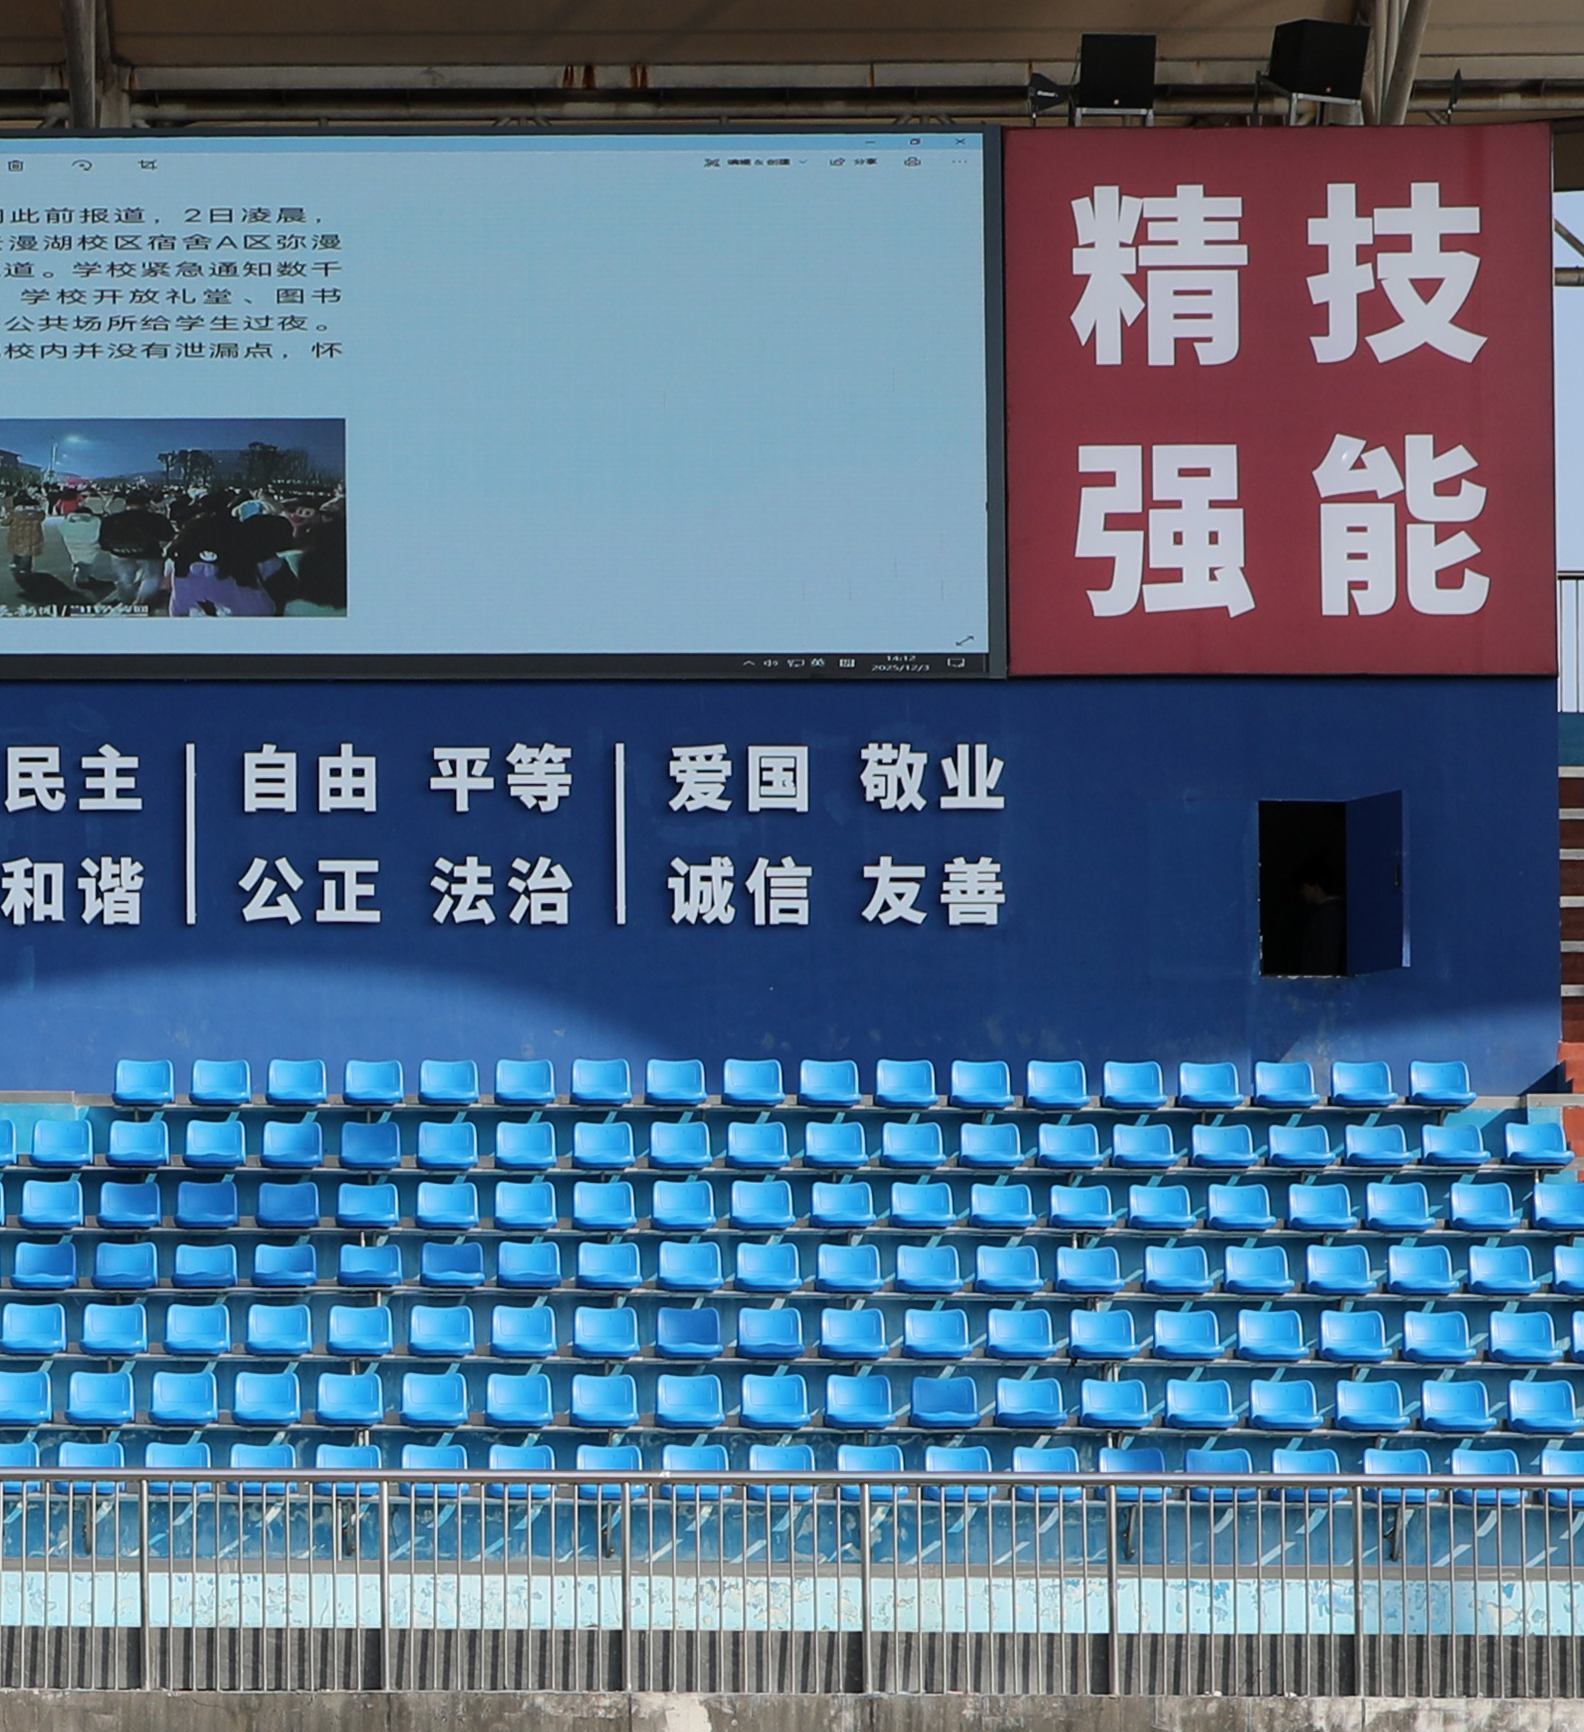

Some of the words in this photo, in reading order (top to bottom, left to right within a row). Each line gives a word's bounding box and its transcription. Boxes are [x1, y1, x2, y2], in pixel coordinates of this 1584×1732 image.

[1071, 183, 1487, 365] 精技
[1076, 434, 1489, 617] 强能
[5, 745, 141, 811] 民主
[245, 744, 376, 811] 自由
[431, 743, 571, 811] 平等
[670, 745, 808, 811] 爱国
[861, 744, 1004, 811] 敬业
[2, 857, 143, 924] 和谐
[239, 858, 380, 924] 公正
[431, 857, 572, 924] 法治
[668, 857, 811, 924] 诚信
[862, 857, 1005, 924] 友善
